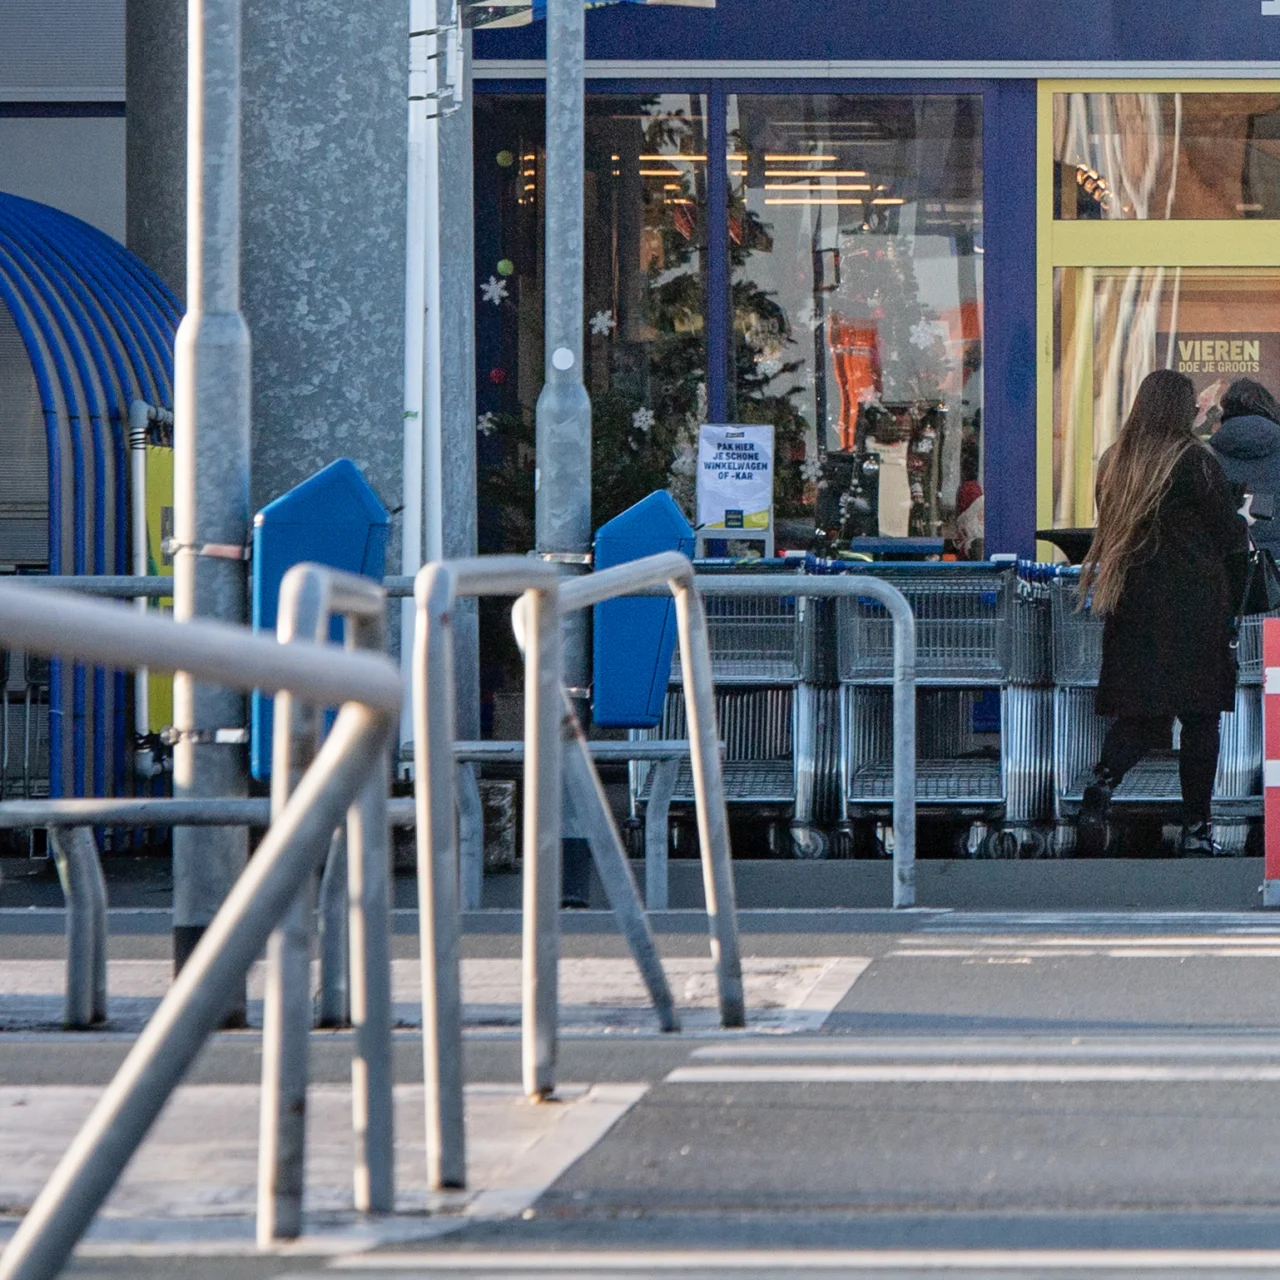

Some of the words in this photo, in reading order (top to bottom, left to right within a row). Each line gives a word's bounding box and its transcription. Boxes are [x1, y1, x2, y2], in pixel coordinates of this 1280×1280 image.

[1178, 341, 1260, 361] VIEREN
[1179, 361, 1200, 372] DOE
[1202, 361, 1216, 372] JE
[1217, 361, 1260, 372] GROOTS
[717, 443, 733, 451] PAK
[735, 443, 755, 451] HIER
[713, 452, 724, 460] JE
[725, 452, 760, 460] SCHONE
[704, 462, 768, 470] WINKELWAGEN
[718, 471, 729, 480] OF
[731, 471, 753, 480] -KAR
